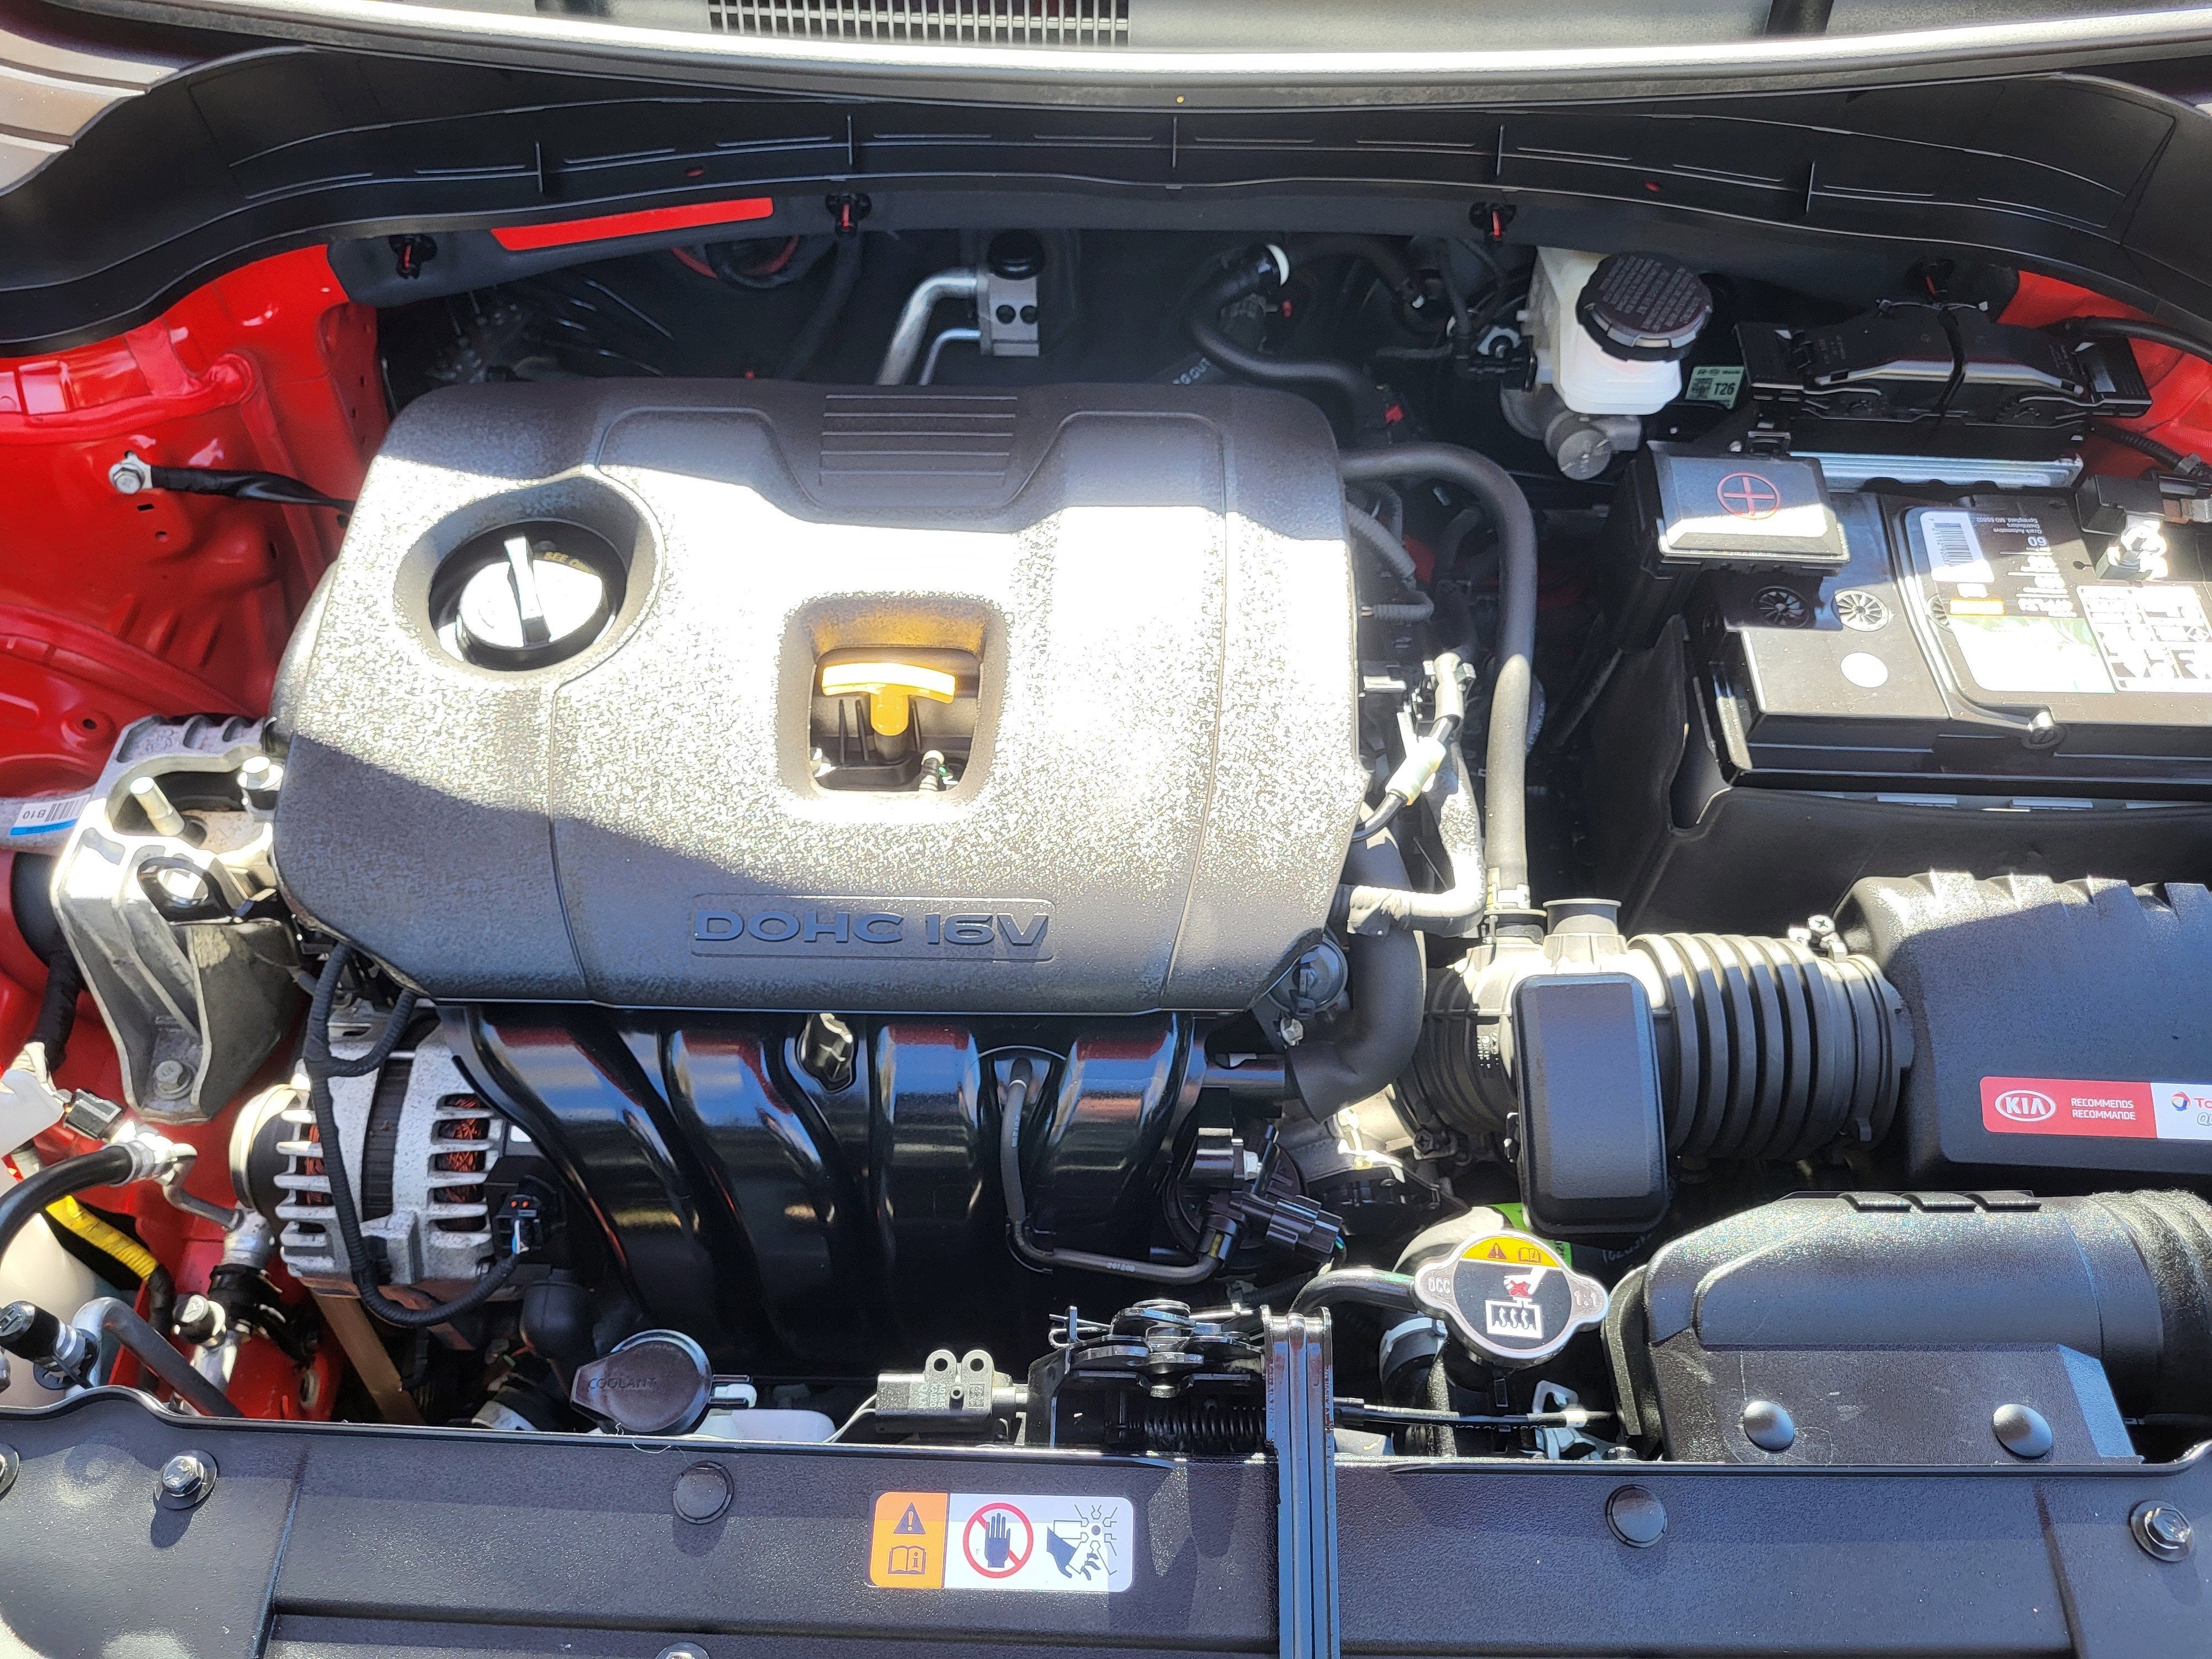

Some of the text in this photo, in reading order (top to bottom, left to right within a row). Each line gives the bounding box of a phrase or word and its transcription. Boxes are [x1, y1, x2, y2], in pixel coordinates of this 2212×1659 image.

[1714, 382, 1736, 395] T26
[22, 809, 46, 820] B10
[694, 910, 1049, 946] DOHC 16V
[2005, 1096, 2046, 1115] KIA
[2070, 1097, 2134, 1109] RECOMMENDS
[2072, 1109, 2137, 1121] RECOMMANDE
[588, 1377, 657, 1390] COOLANT
